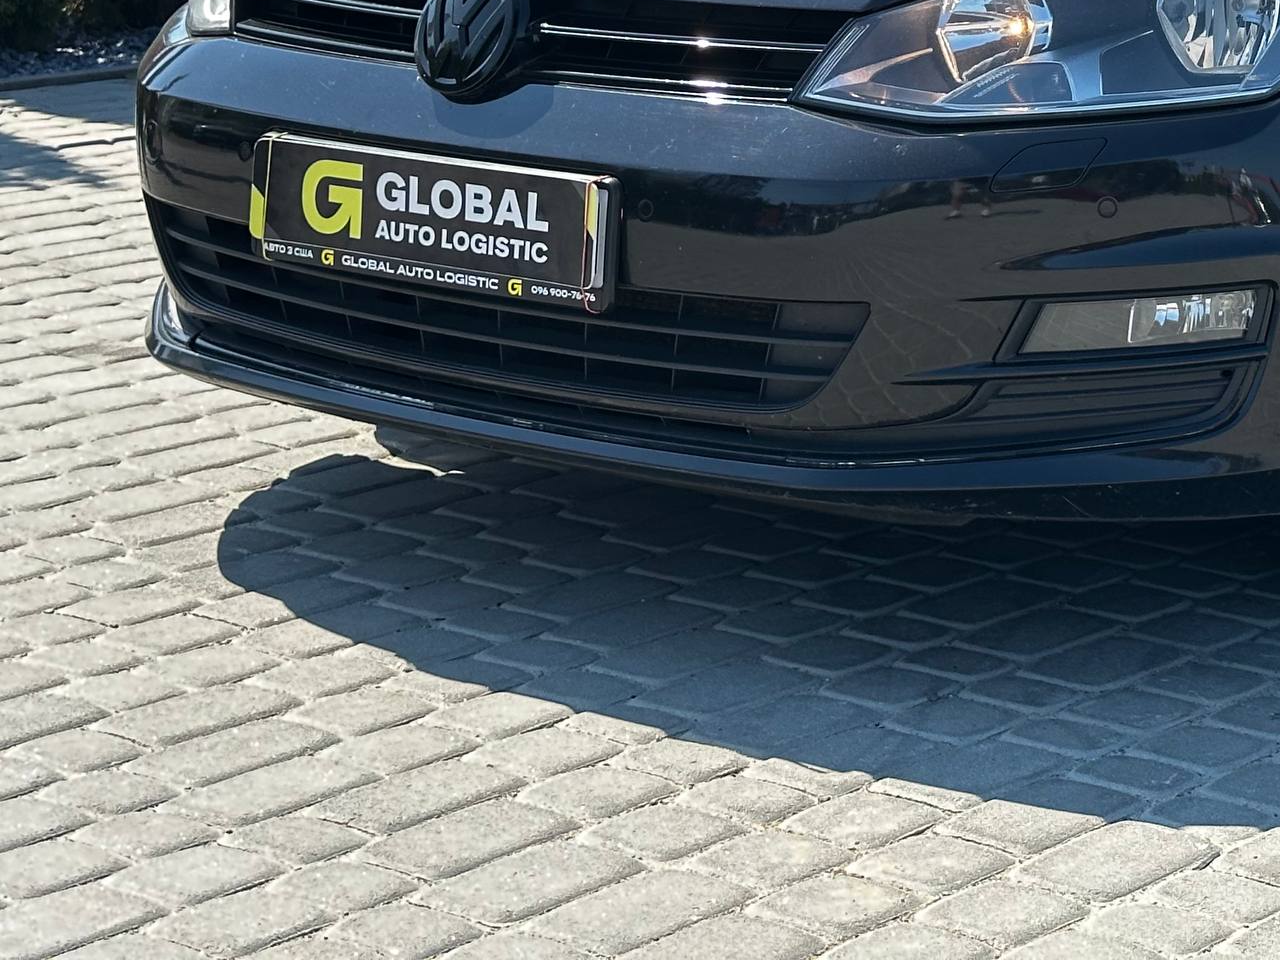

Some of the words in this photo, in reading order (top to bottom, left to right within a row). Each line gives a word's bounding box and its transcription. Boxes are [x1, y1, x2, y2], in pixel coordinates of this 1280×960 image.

[375, 171, 549, 232] GLOBAL
[375, 219, 435, 248] AUTO
[441, 229, 549, 264] LOGISTIC
[341, 255, 395, 274] GLOBAL
[396, 264, 434, 279] AUTO
[436, 269, 499, 290] LOGISTIC
